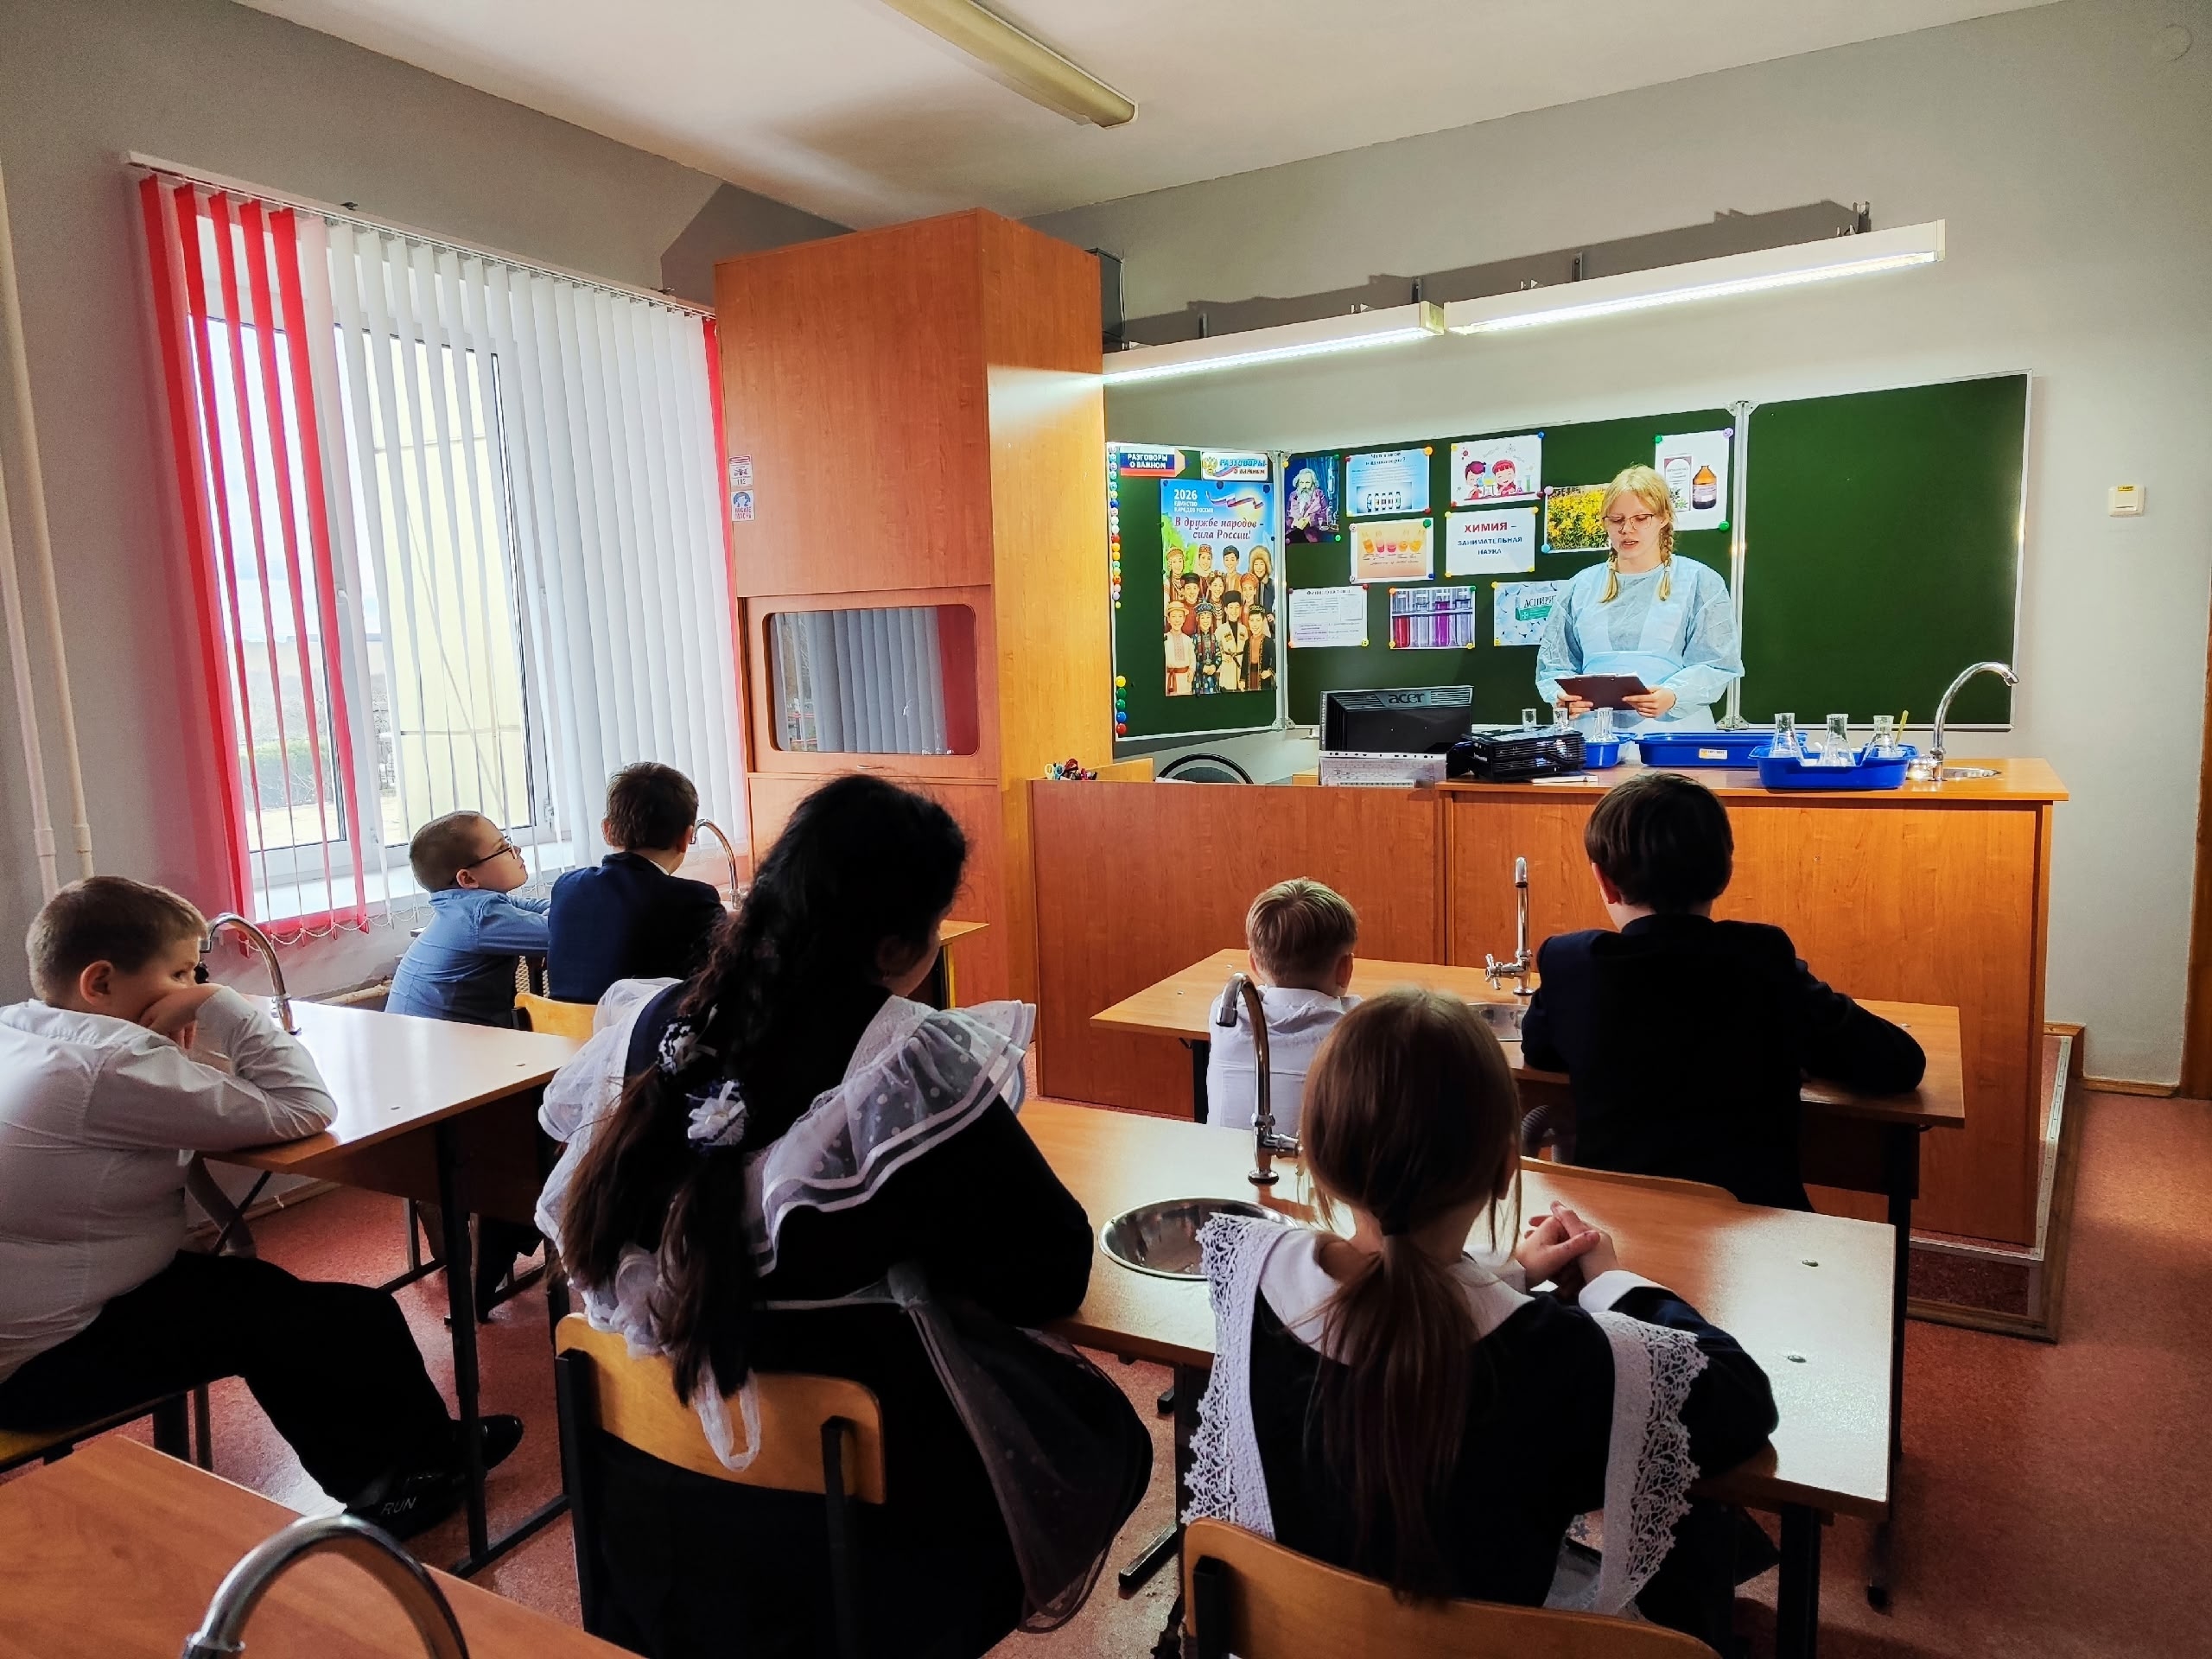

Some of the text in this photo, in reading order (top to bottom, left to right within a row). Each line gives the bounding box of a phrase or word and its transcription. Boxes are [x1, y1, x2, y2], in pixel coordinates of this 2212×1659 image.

[1173, 489, 1198, 500] 2026
[1174, 517, 1181, 527] В
[1184, 517, 1218, 531] дружбе
[1220, 518, 1257, 530] народов
[1464, 522, 1508, 533] ХИМИЯ
[1192, 529, 1251, 540] сила России!
[1457, 537, 1522, 546] ЗАНИМАТЕЛЬНАЯ
[1388, 693, 1425, 704] acer
[381, 1497, 416, 1515] RUN
